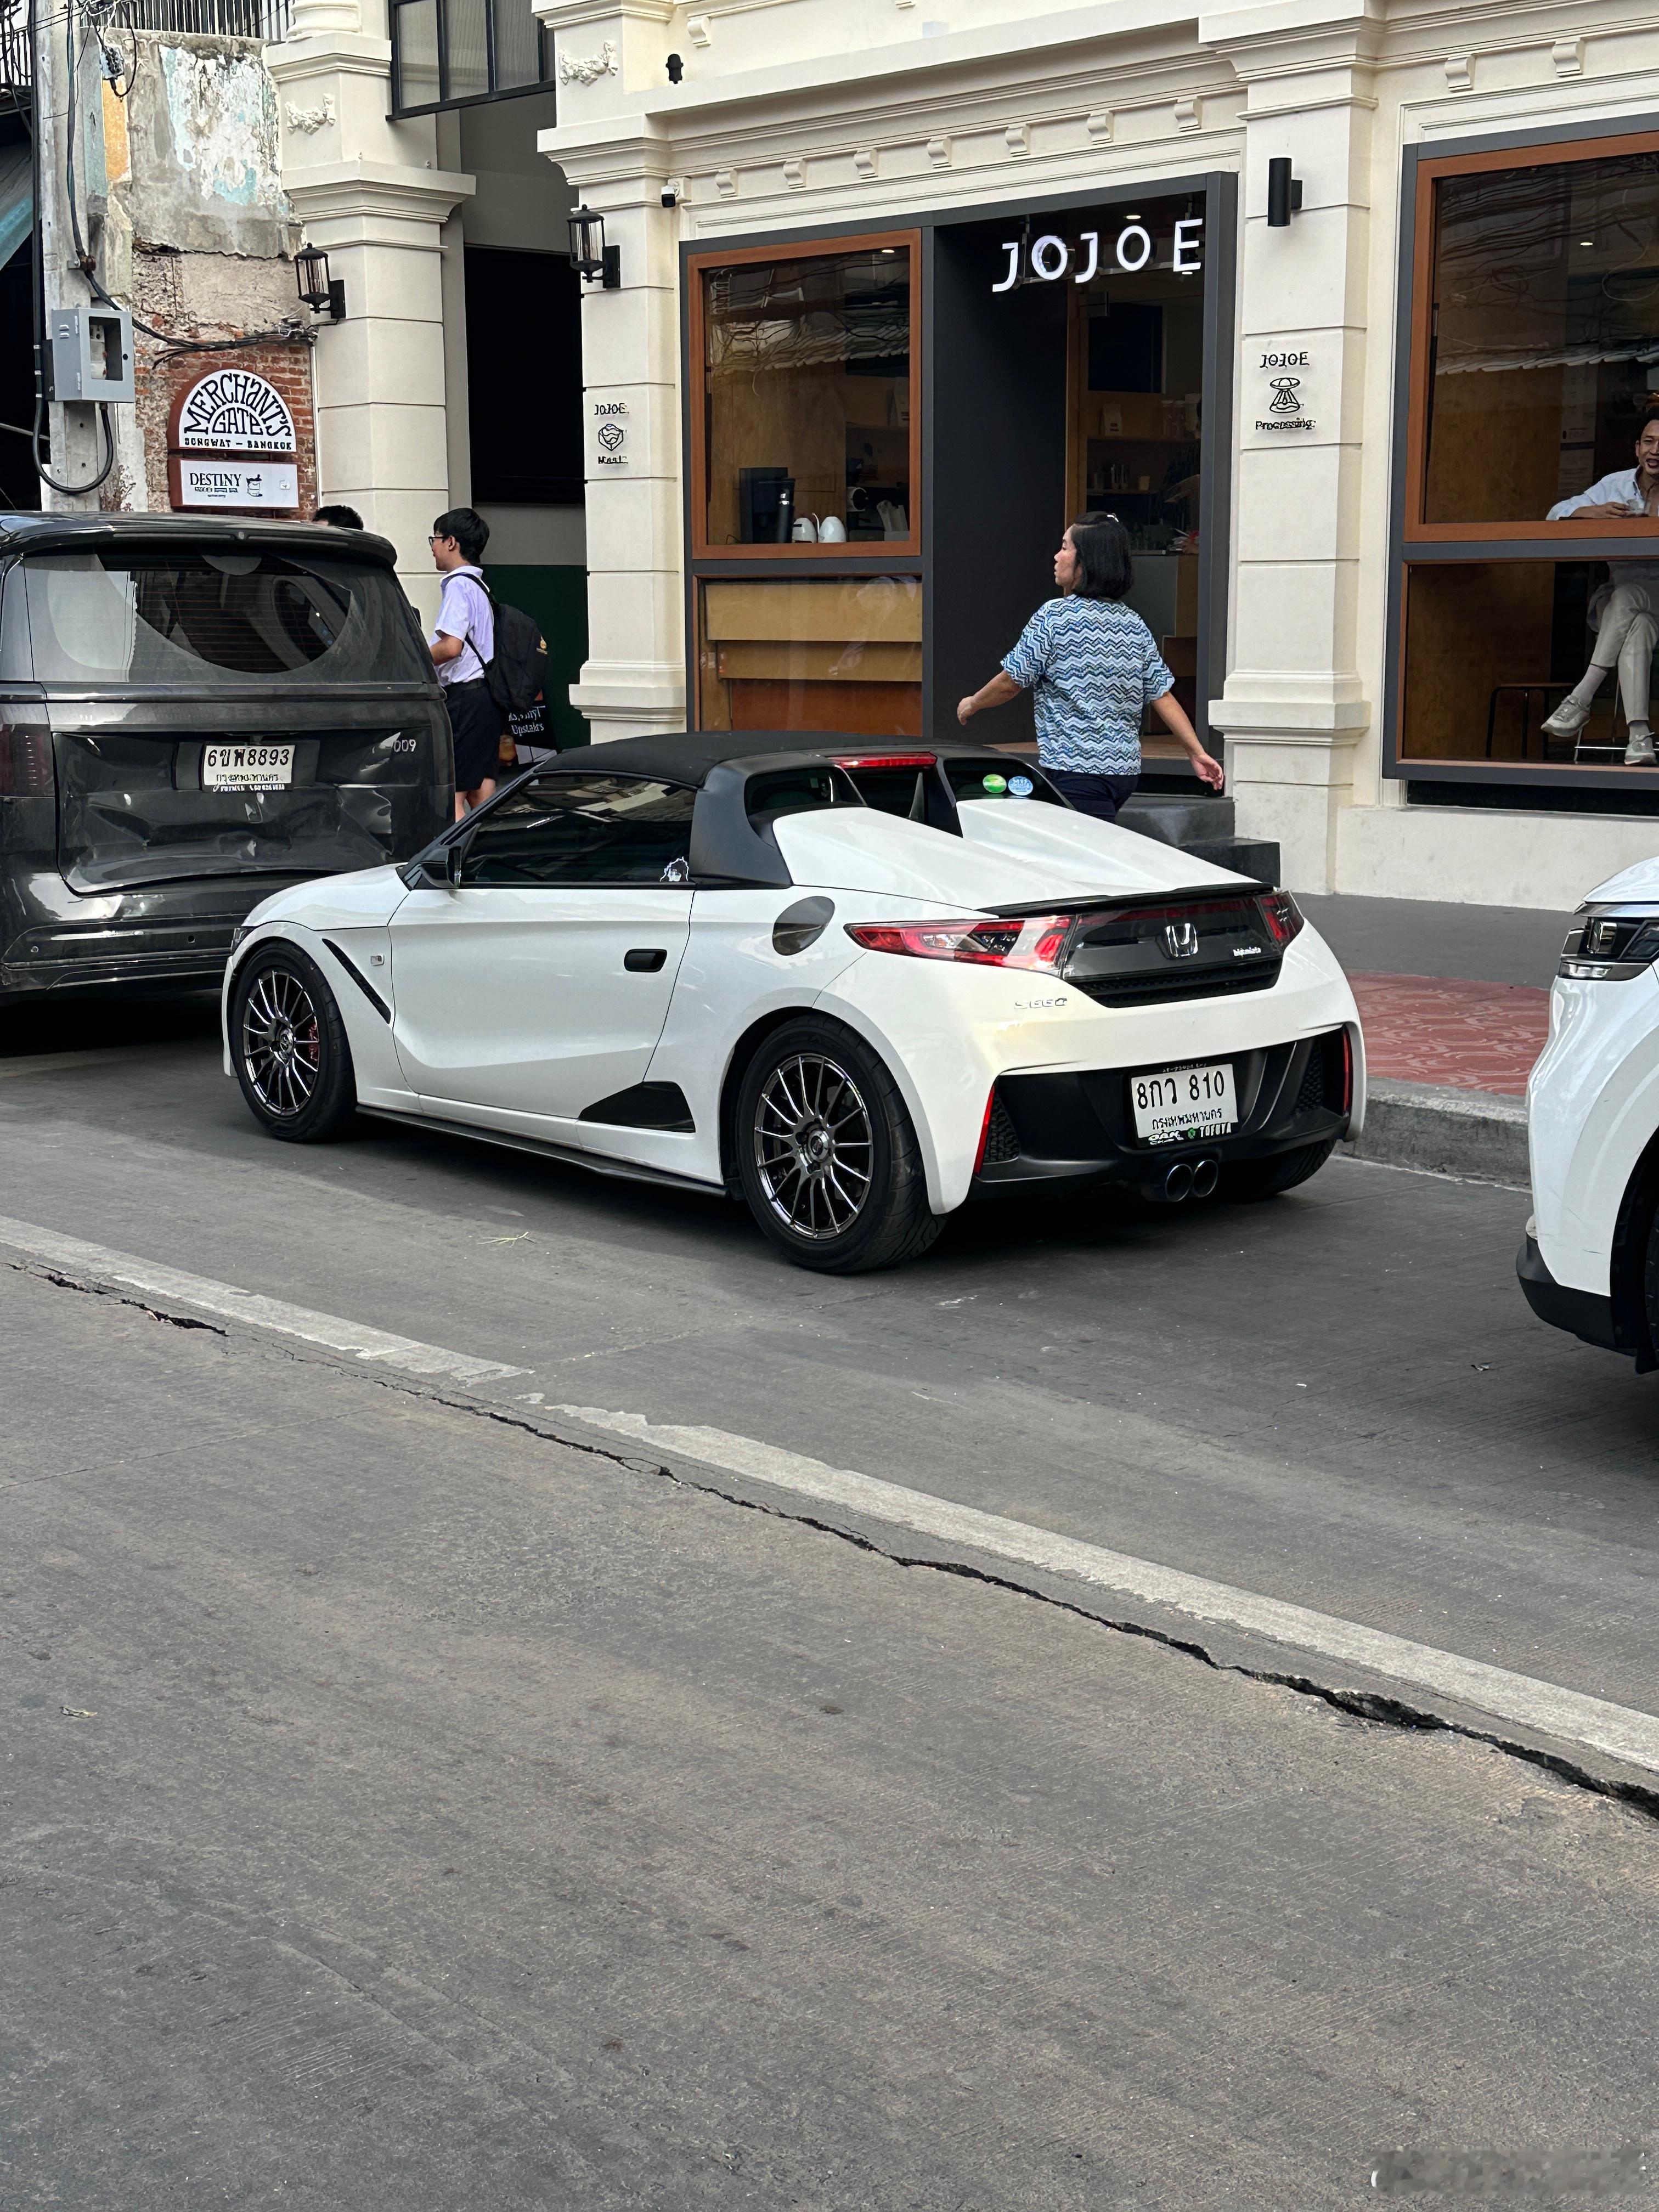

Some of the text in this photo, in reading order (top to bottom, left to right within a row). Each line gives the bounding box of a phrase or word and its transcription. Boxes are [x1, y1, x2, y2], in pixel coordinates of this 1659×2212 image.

[992, 218, 1203, 292] JOJOE
[1260, 352, 1310, 369] JOJOE
[594, 403, 629, 415] JOJOE
[190, 473, 241, 487] DESTINY
[1189, 1070, 1224, 1101] 810
